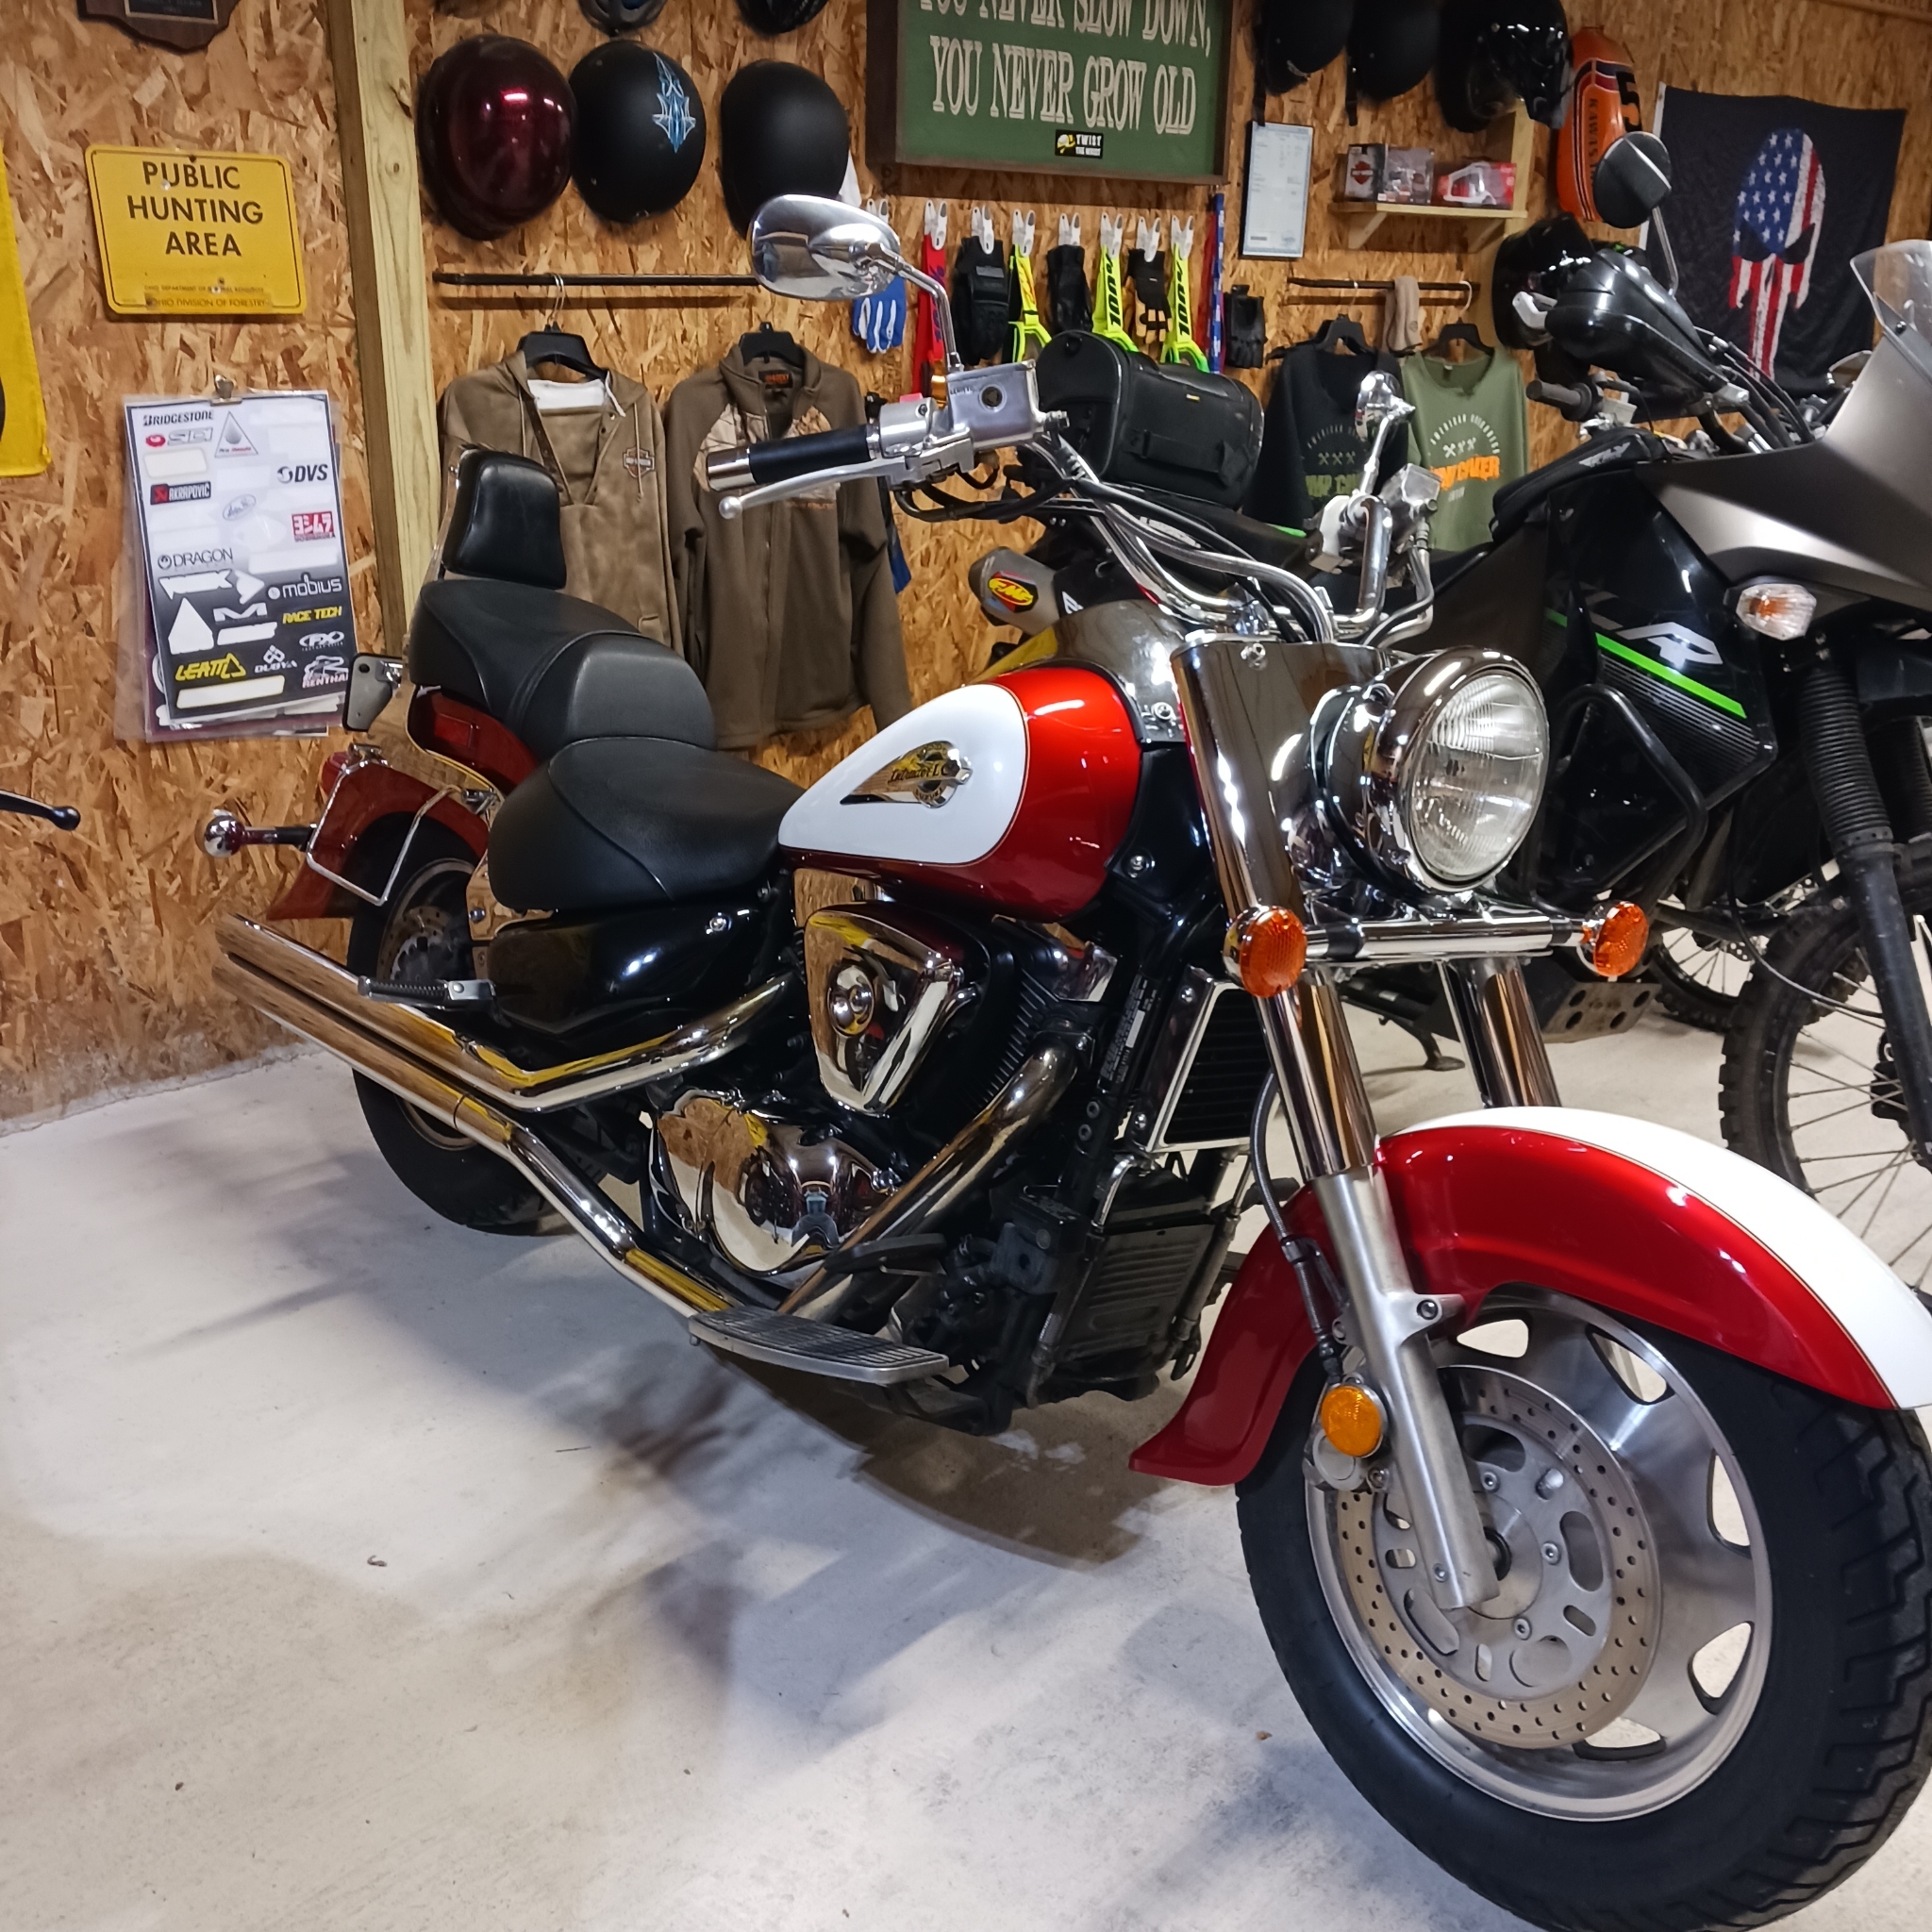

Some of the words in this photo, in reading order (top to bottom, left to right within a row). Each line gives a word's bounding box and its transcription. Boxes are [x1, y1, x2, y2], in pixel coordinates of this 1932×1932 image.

[929, 35, 982, 116] YOU
[990, 43, 1074, 125] NEVER
[1083, 55, 1147, 131] GROW
[1154, 64, 1196, 135] OLD
[142, 160, 241, 190] PUBLIC
[126, 195, 264, 225] HUNTING
[165, 231, 242, 257] AREA
[177, 298, 213, 308] DIVISION
[229, 298, 265, 308] FORESTRY
[143, 410, 213, 426] BRIDGESTONE
[294, 463, 328, 483] DVS
[173, 548, 234, 567] DRAGON
[282, 574, 342, 598] mobius
[282, 610, 312, 625] RACE
[314, 606, 342, 620] TECH
[915, 787, 943, 802] SUZUKI
